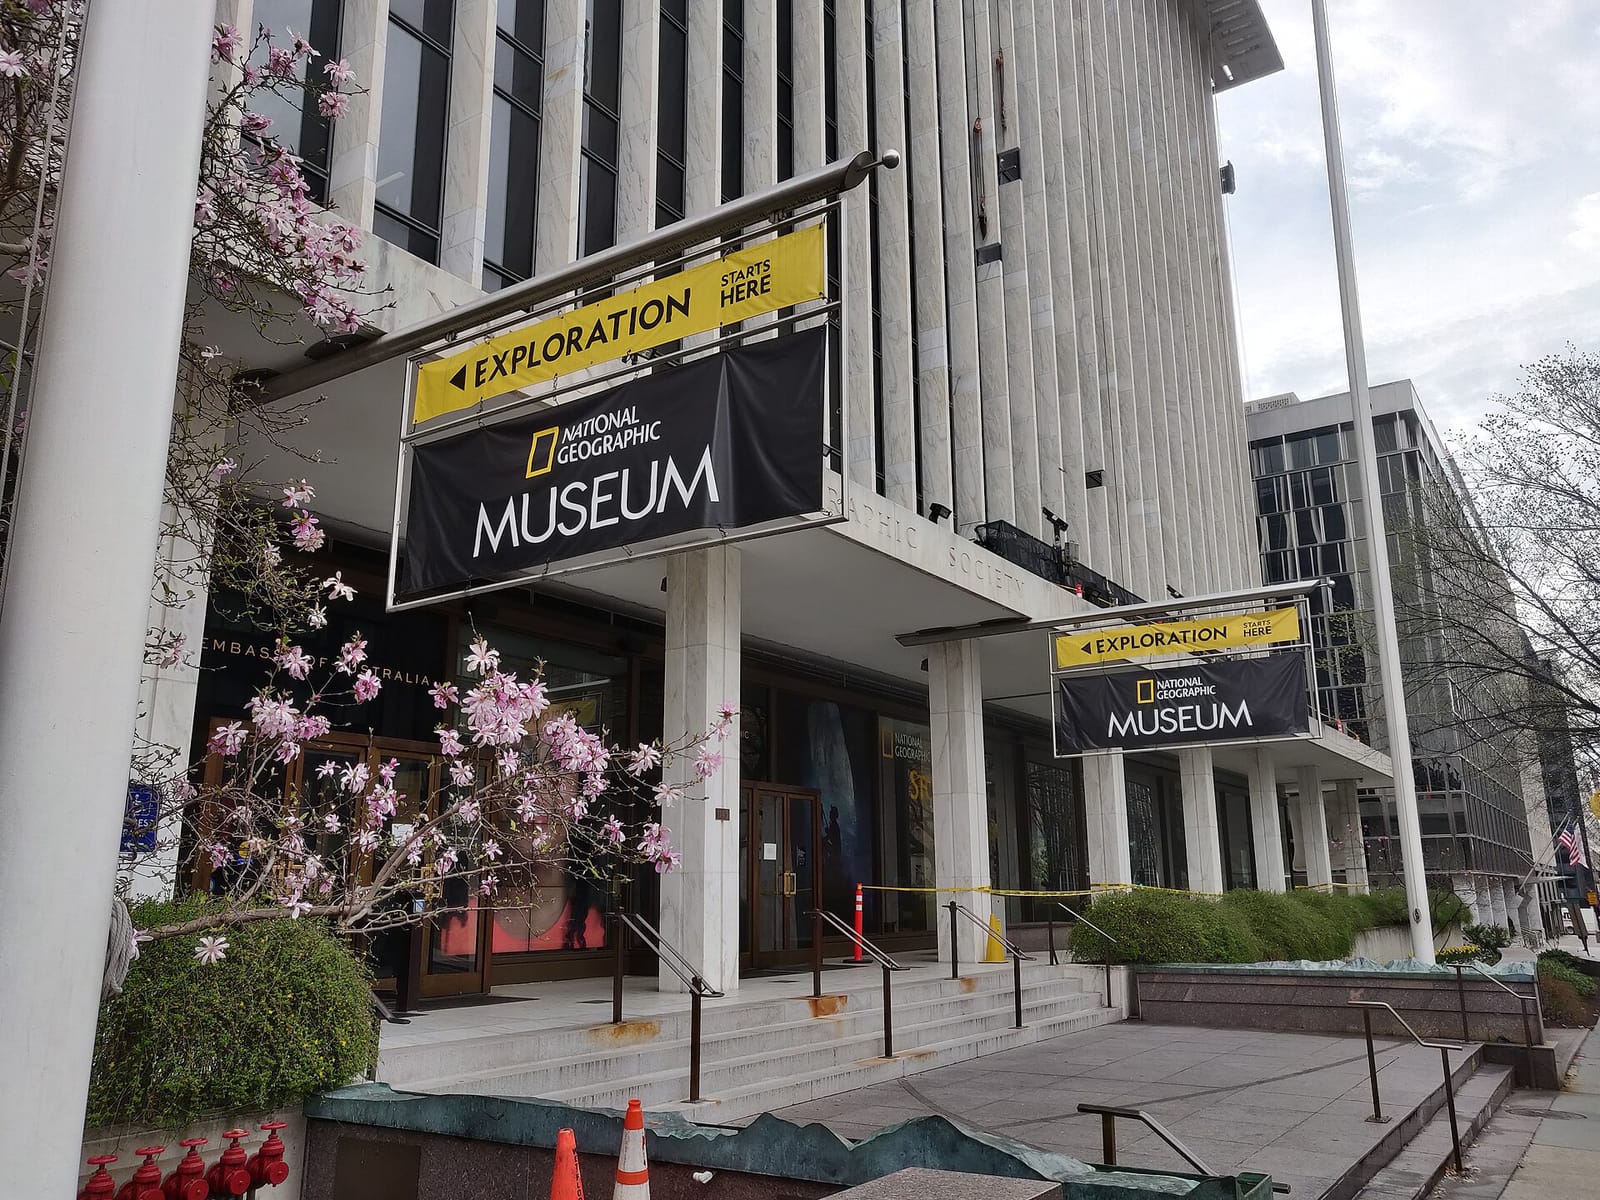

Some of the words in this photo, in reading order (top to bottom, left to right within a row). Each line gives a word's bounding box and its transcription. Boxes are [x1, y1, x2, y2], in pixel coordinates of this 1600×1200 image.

[721, 258, 771, 287] STARTS
[721, 275, 771, 308] HERE
[475, 288, 691, 388] EXPLORATION
[562, 405, 640, 443] NATIONAL
[557, 420, 661, 464] GEOGRAPHIC
[473, 444, 719, 558] MUSEUM
[949, 547, 1025, 595] SOCIETY
[1097, 626, 1227, 654] EXPLORATION
[1243, 620, 1271, 629] STARTS
[1243, 625, 1272, 638] HERE
[201, 638, 281, 660] EMBASS
[339, 658, 430, 686] USTRALIA
[1156, 676, 1203, 690] NATIONAL
[1156, 684, 1216, 700] GEOGRAPHIC
[1107, 699, 1253, 738] MUSEUM
